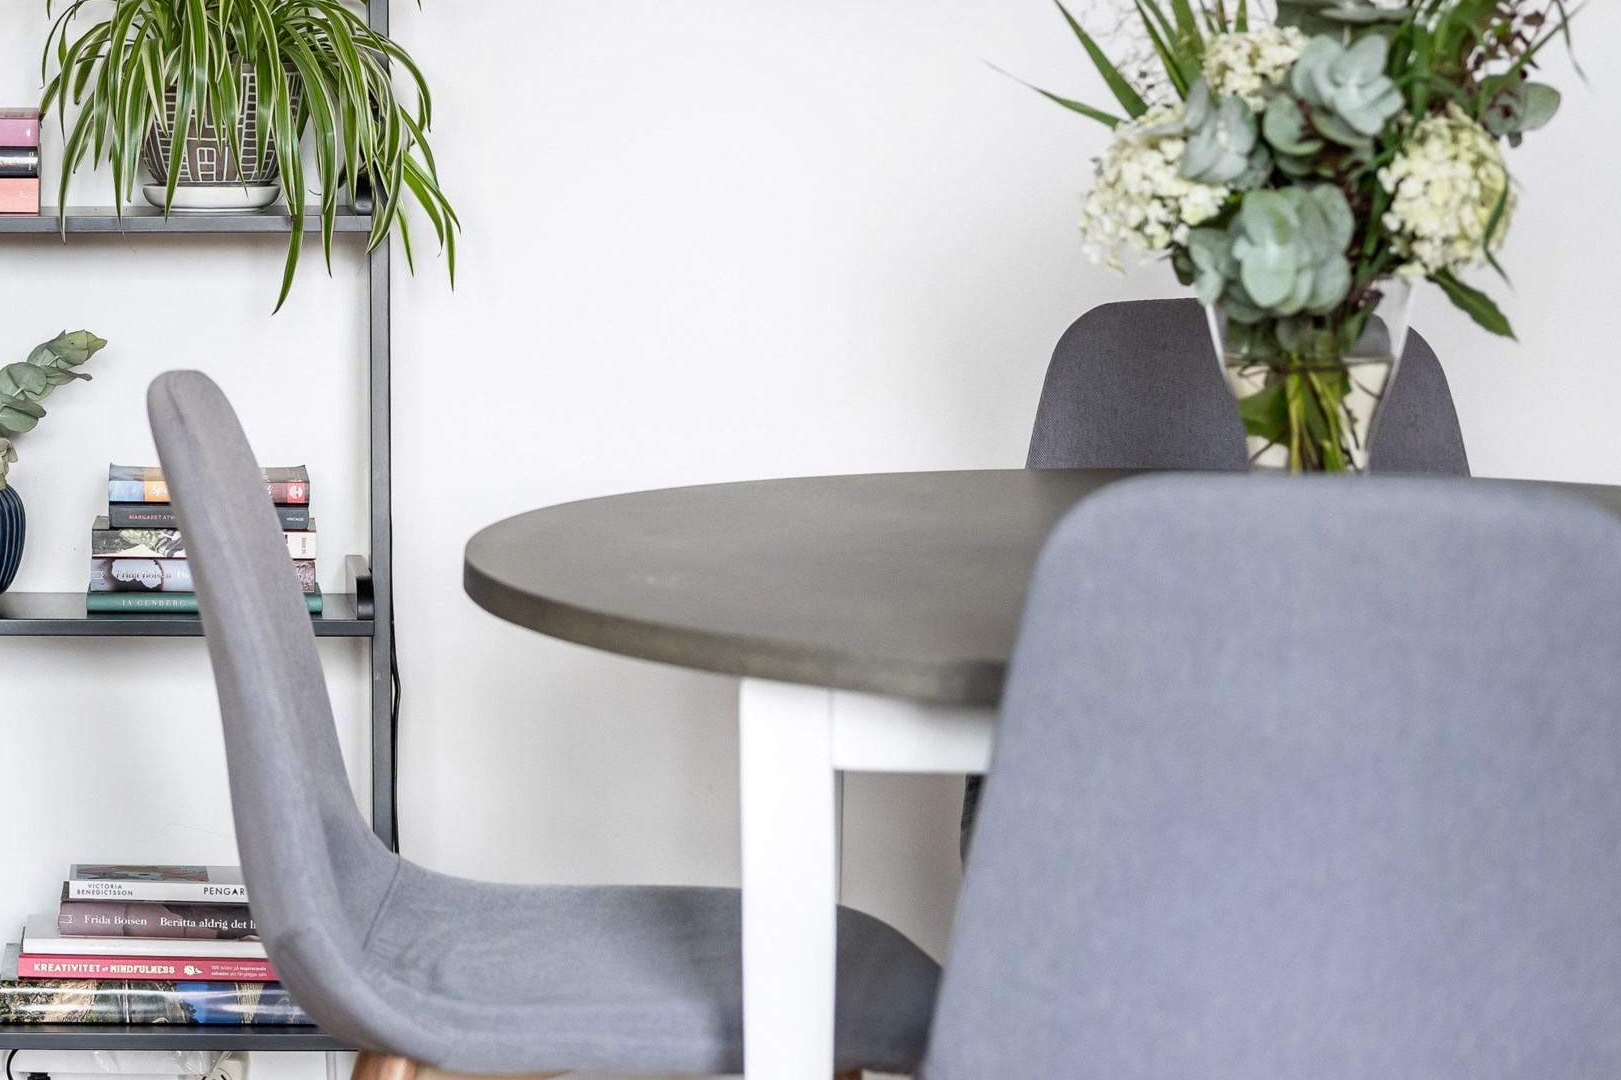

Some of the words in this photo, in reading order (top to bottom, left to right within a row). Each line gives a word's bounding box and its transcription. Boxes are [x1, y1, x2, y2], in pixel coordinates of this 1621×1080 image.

[203, 887, 245, 896] PENGAR
[85, 915, 110, 924] Frida
[114, 916, 147, 925] Boisen
[160, 917, 196, 927] Berätta
[199, 919, 228, 930] aldrig
[231, 919, 247, 929] det
[34, 963, 100, 973] KREATIVITET
[110, 965, 175, 974] MINDFULNESS
